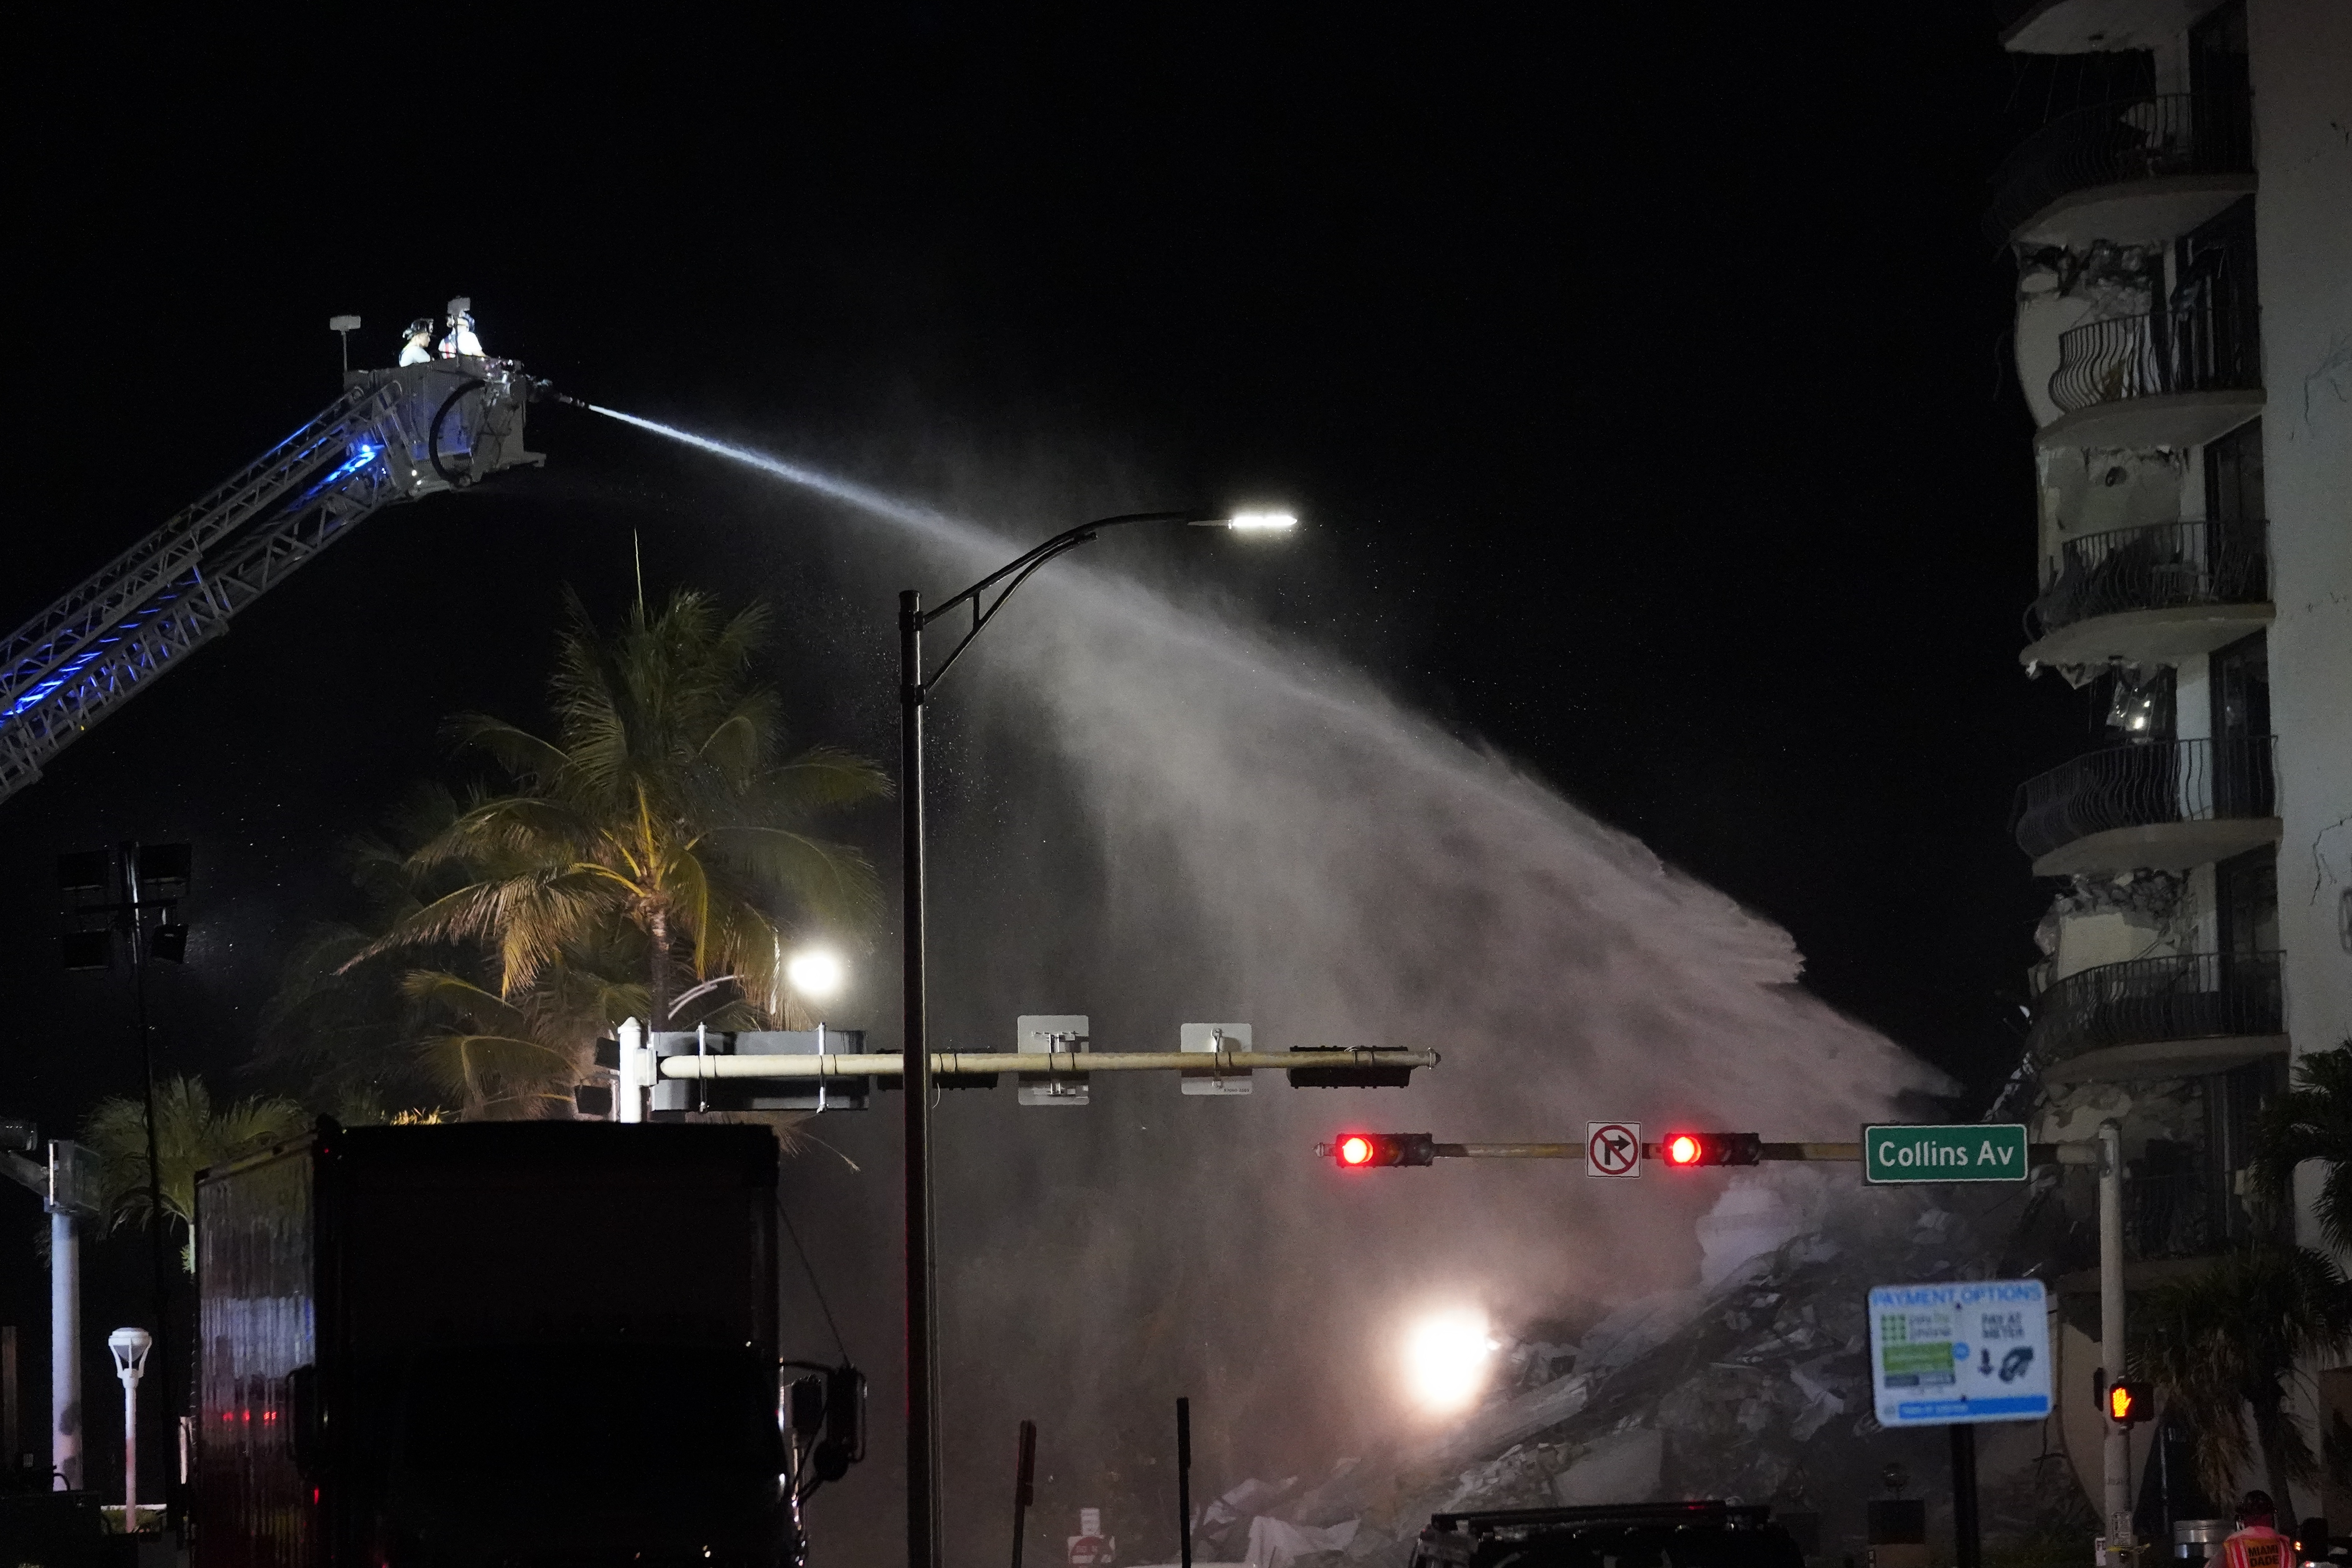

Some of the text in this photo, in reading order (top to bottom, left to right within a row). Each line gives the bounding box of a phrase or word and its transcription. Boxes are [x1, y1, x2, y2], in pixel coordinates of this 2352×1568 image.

[1879, 1140, 2014, 1167] Collins Av
[1872, 1282, 2042, 1306] PAYMENT OPTIONS
[2248, 1545, 2278, 1556] MIAMI
[2250, 1555, 2279, 1567] DADE
